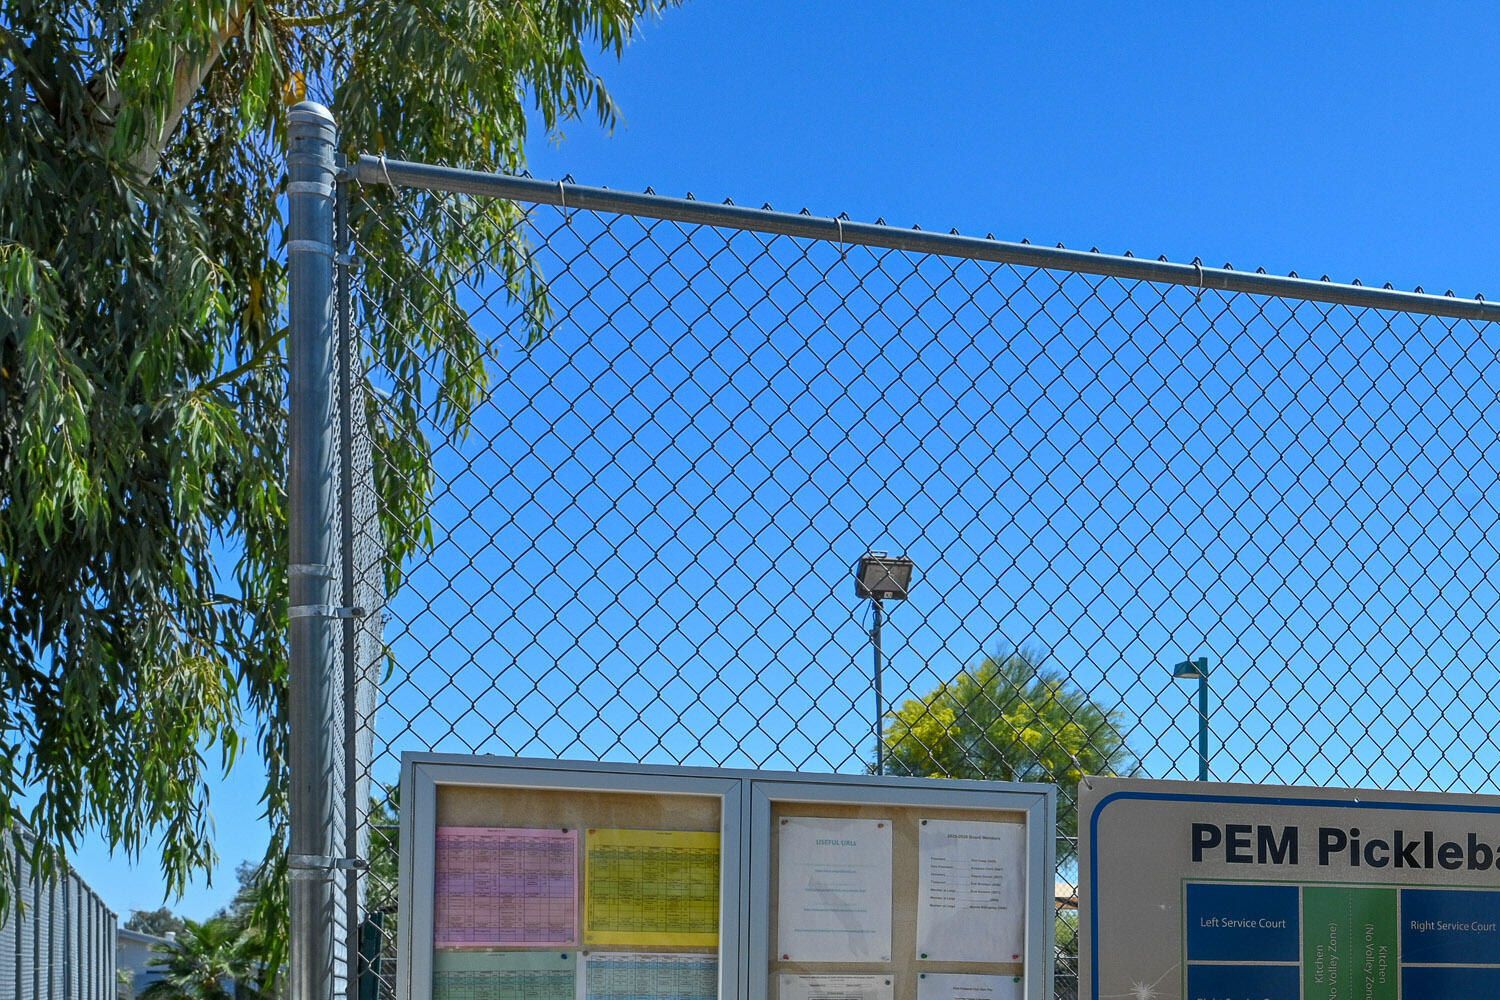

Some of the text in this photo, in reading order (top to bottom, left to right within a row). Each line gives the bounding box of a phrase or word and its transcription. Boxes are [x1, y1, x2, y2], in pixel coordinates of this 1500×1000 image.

[1192, 823, 1298, 865] PEM
[1200, 918, 1286, 928] Left Service Court
[1328, 922, 1338, 952] Zone)
[1365, 924, 1374, 942] (No
[1411, 920, 1496, 932] Right Service Court
[1315, 944, 1324, 984] Kitchen
[1328, 954, 1339, 986] Volley
[1364, 944, 1374, 973] Volley
